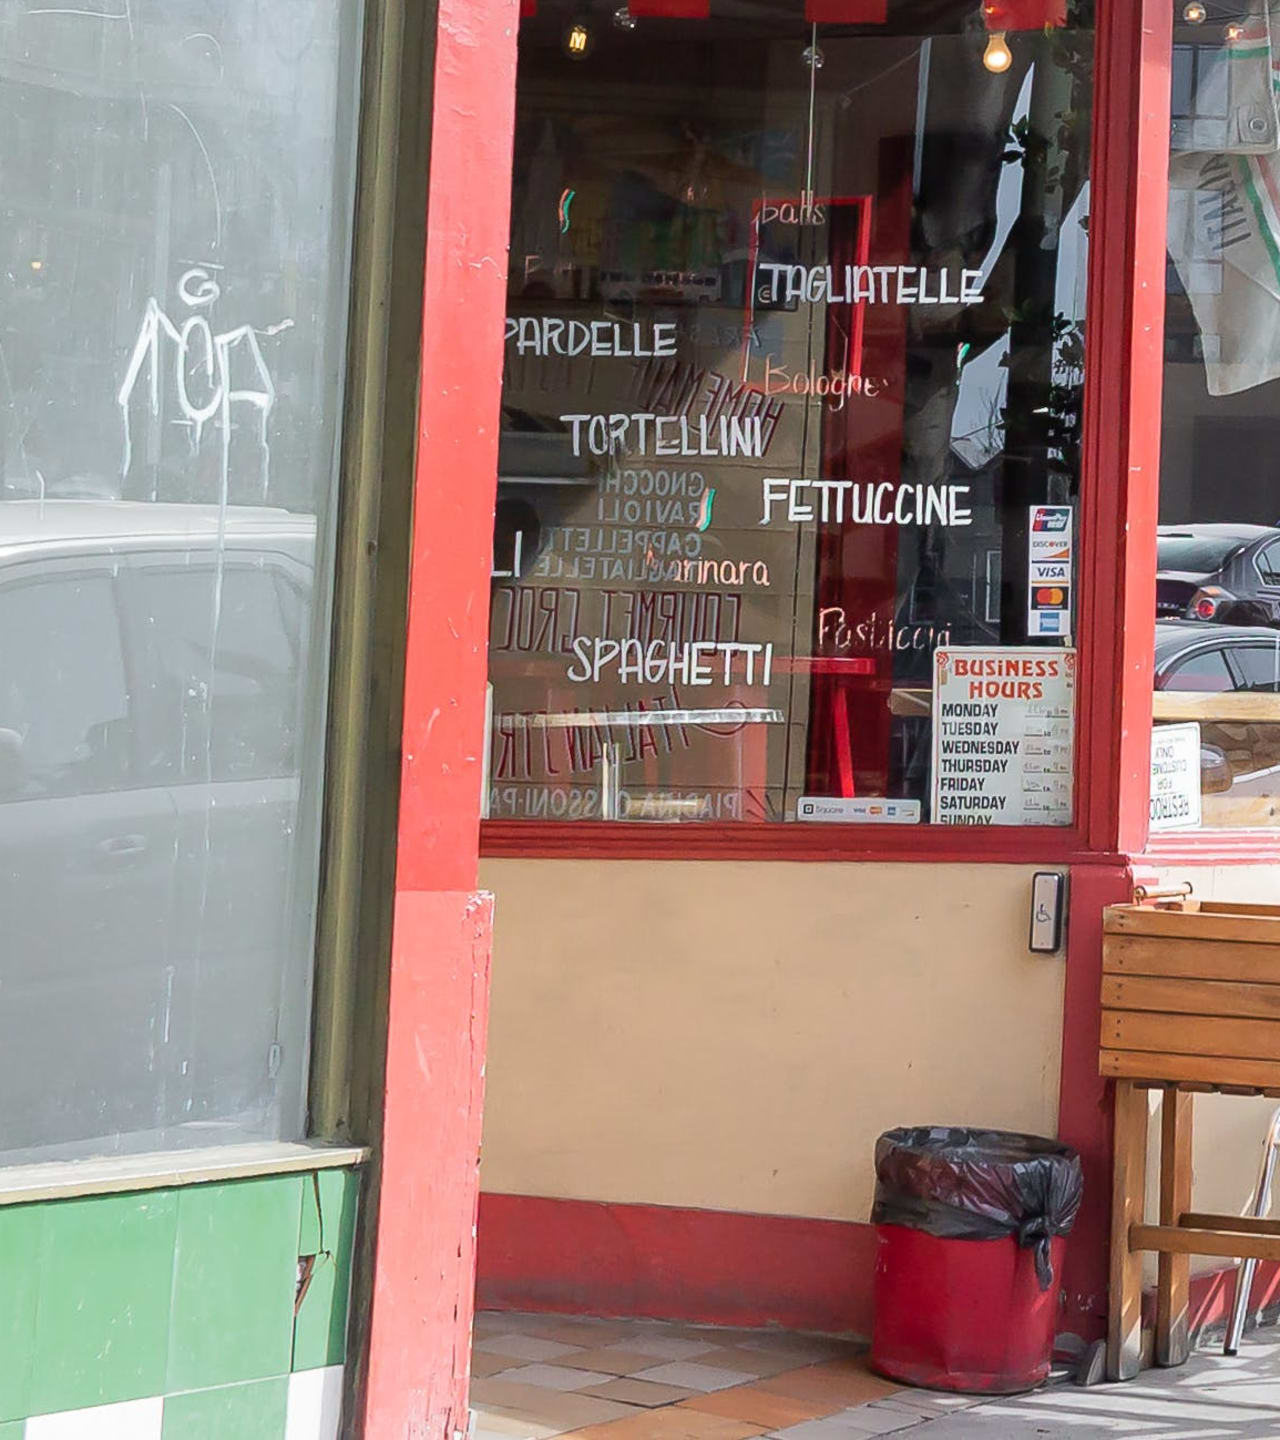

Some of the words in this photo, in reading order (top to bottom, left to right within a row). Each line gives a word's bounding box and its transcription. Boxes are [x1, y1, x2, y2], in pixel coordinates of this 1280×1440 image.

[758, 262, 984, 305] TAGLIATELLE
[560, 413, 763, 458] TORTELLINI
[759, 478, 973, 526] FETTUCCINE
[1037, 567, 1065, 577] VISA
[567, 636, 773, 686] SPAGHETTI
[969, 681, 1043, 700] HOURS
[942, 703, 998, 718] MONDAY
[942, 722, 998, 736] TUESDAY
[942, 740, 1020, 754] WEDNESDAY
[942, 759, 1008, 773] THURSDAY
[940, 777, 985, 791] FRIDAY
[940, 796, 1007, 810] SATURDAY
[941, 814, 992, 825] SUNDAY
